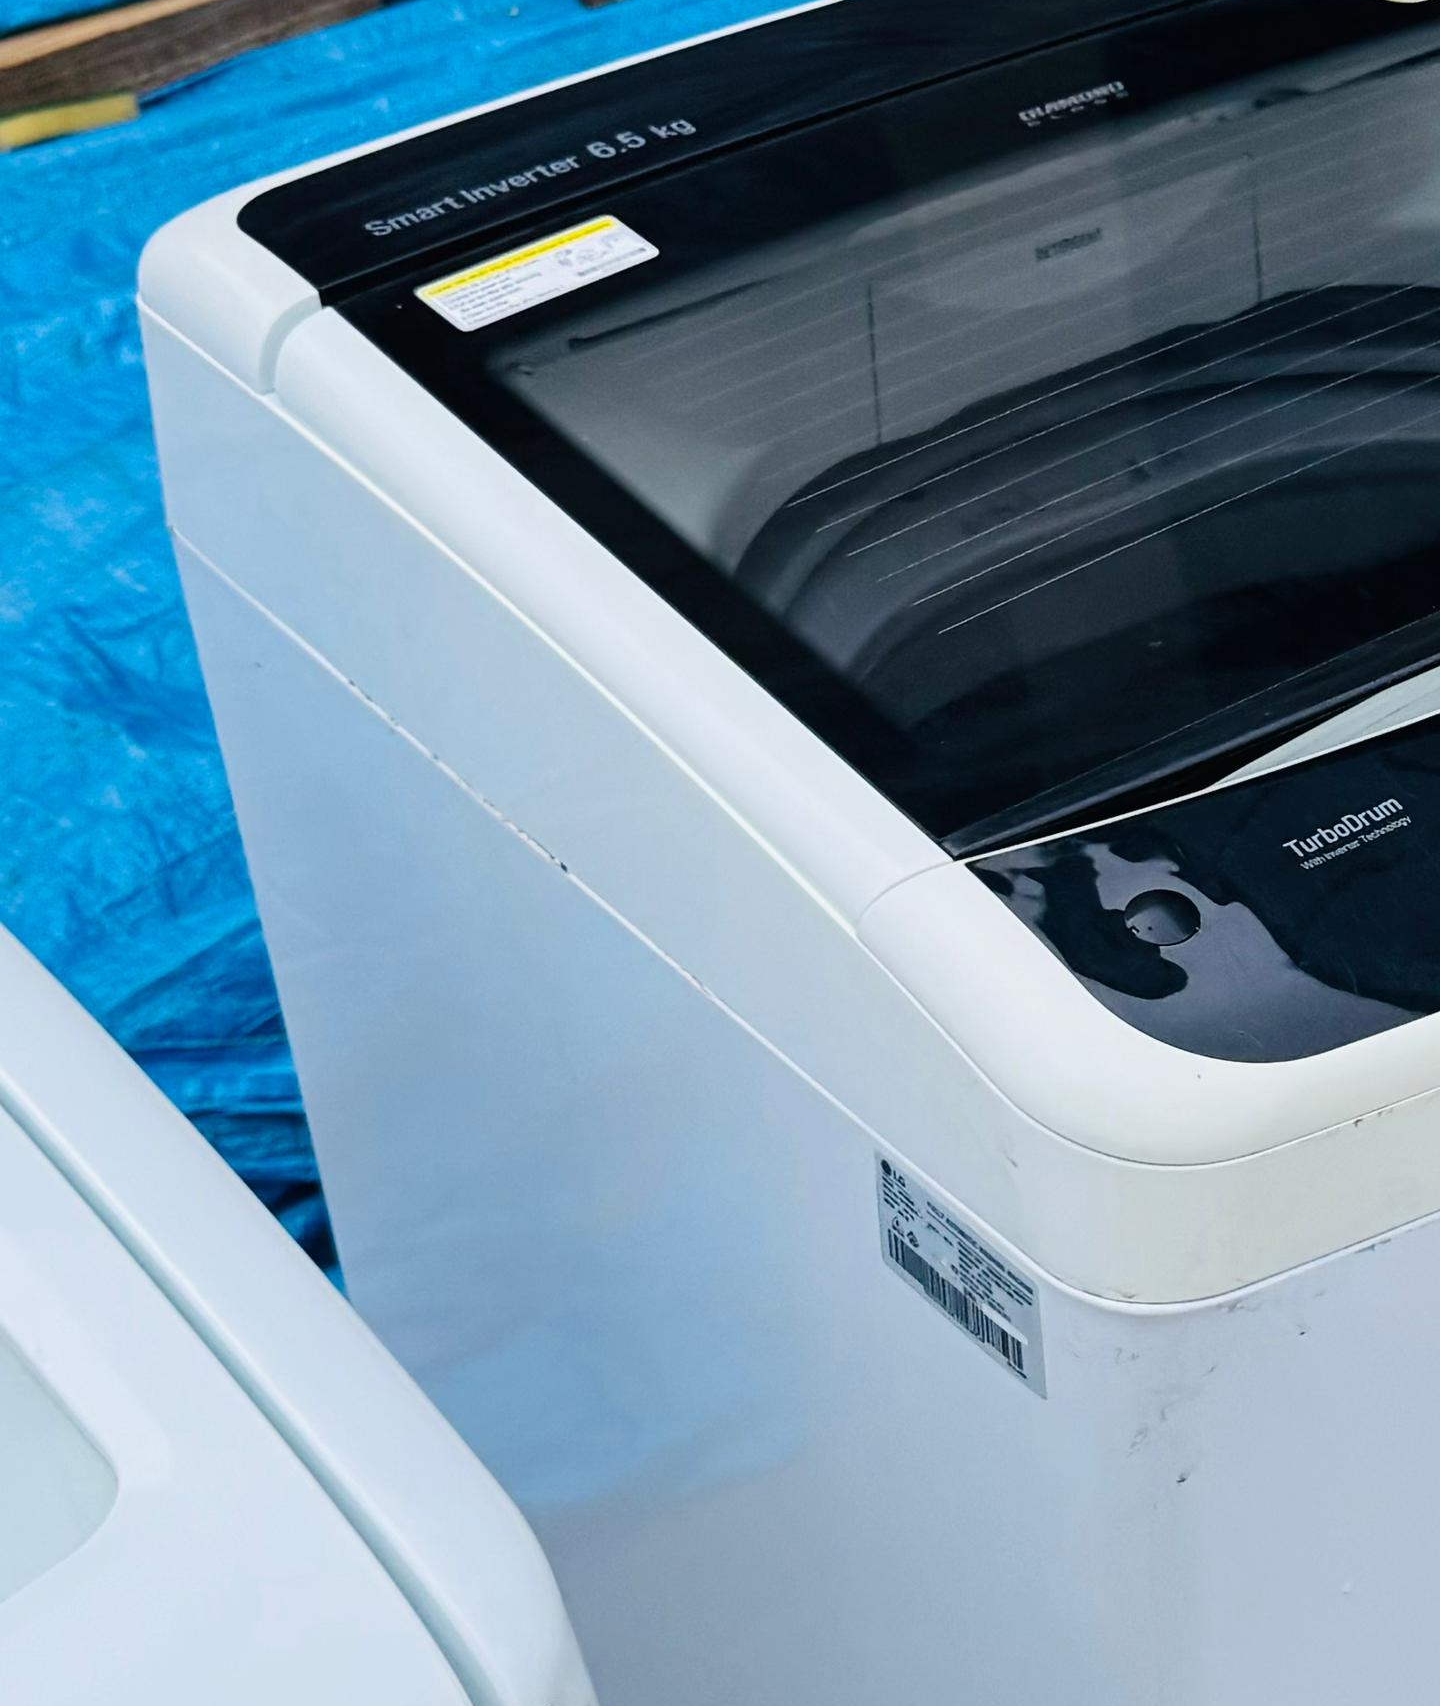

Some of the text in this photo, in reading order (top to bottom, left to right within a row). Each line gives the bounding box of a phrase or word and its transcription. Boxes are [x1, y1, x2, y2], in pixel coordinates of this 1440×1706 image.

[364, 117, 697, 237] Smart Inverter 6.5 kg
[1282, 798, 1403, 857] TurboDrum
[1300, 816, 1412, 870] With Inverter Technology
